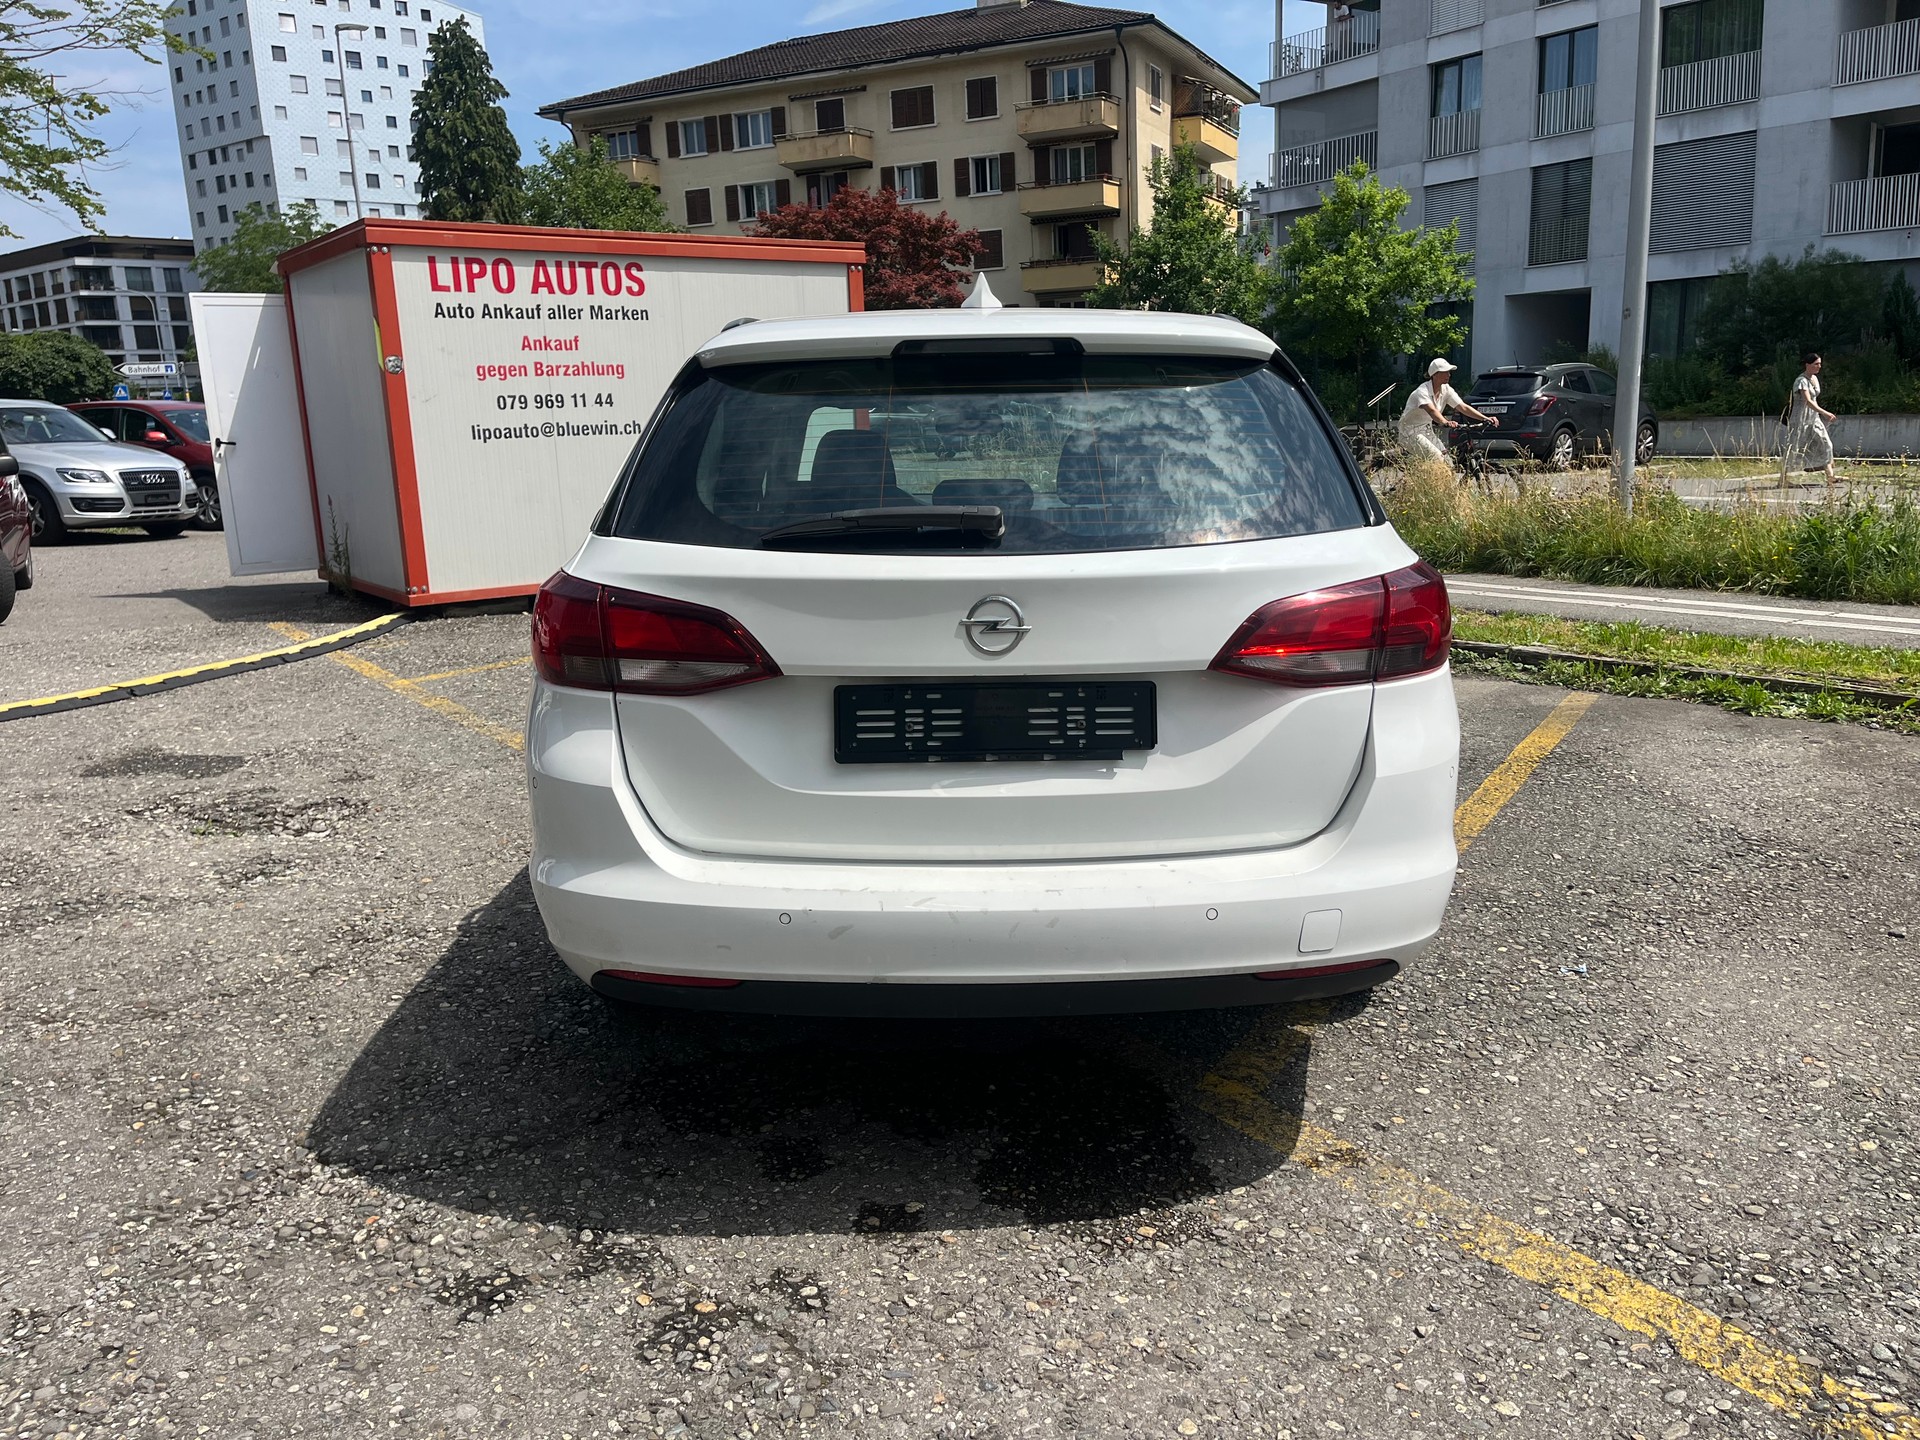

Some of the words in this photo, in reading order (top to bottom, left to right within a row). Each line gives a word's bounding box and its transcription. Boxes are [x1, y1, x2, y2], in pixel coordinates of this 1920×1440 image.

[427, 256, 516, 294] LIPO
[531, 259, 646, 297] AUTOS
[434, 303, 474, 319] Auto
[482, 304, 541, 319] Ankauf
[548, 305, 583, 320] aller
[590, 305, 649, 320] Marken
[521, 336, 580, 351] Ankauf
[128, 366, 160, 374] Bahnhof
[477, 365, 527, 381] gegen
[534, 361, 624, 379] Barzahlung
[497, 395, 528, 410] 079
[534, 394, 564, 409] 969
[571, 393, 586, 407] 11
[595, 393, 613, 407] 44
[471, 420, 642, 443] lipoauto@bluewin.ch
